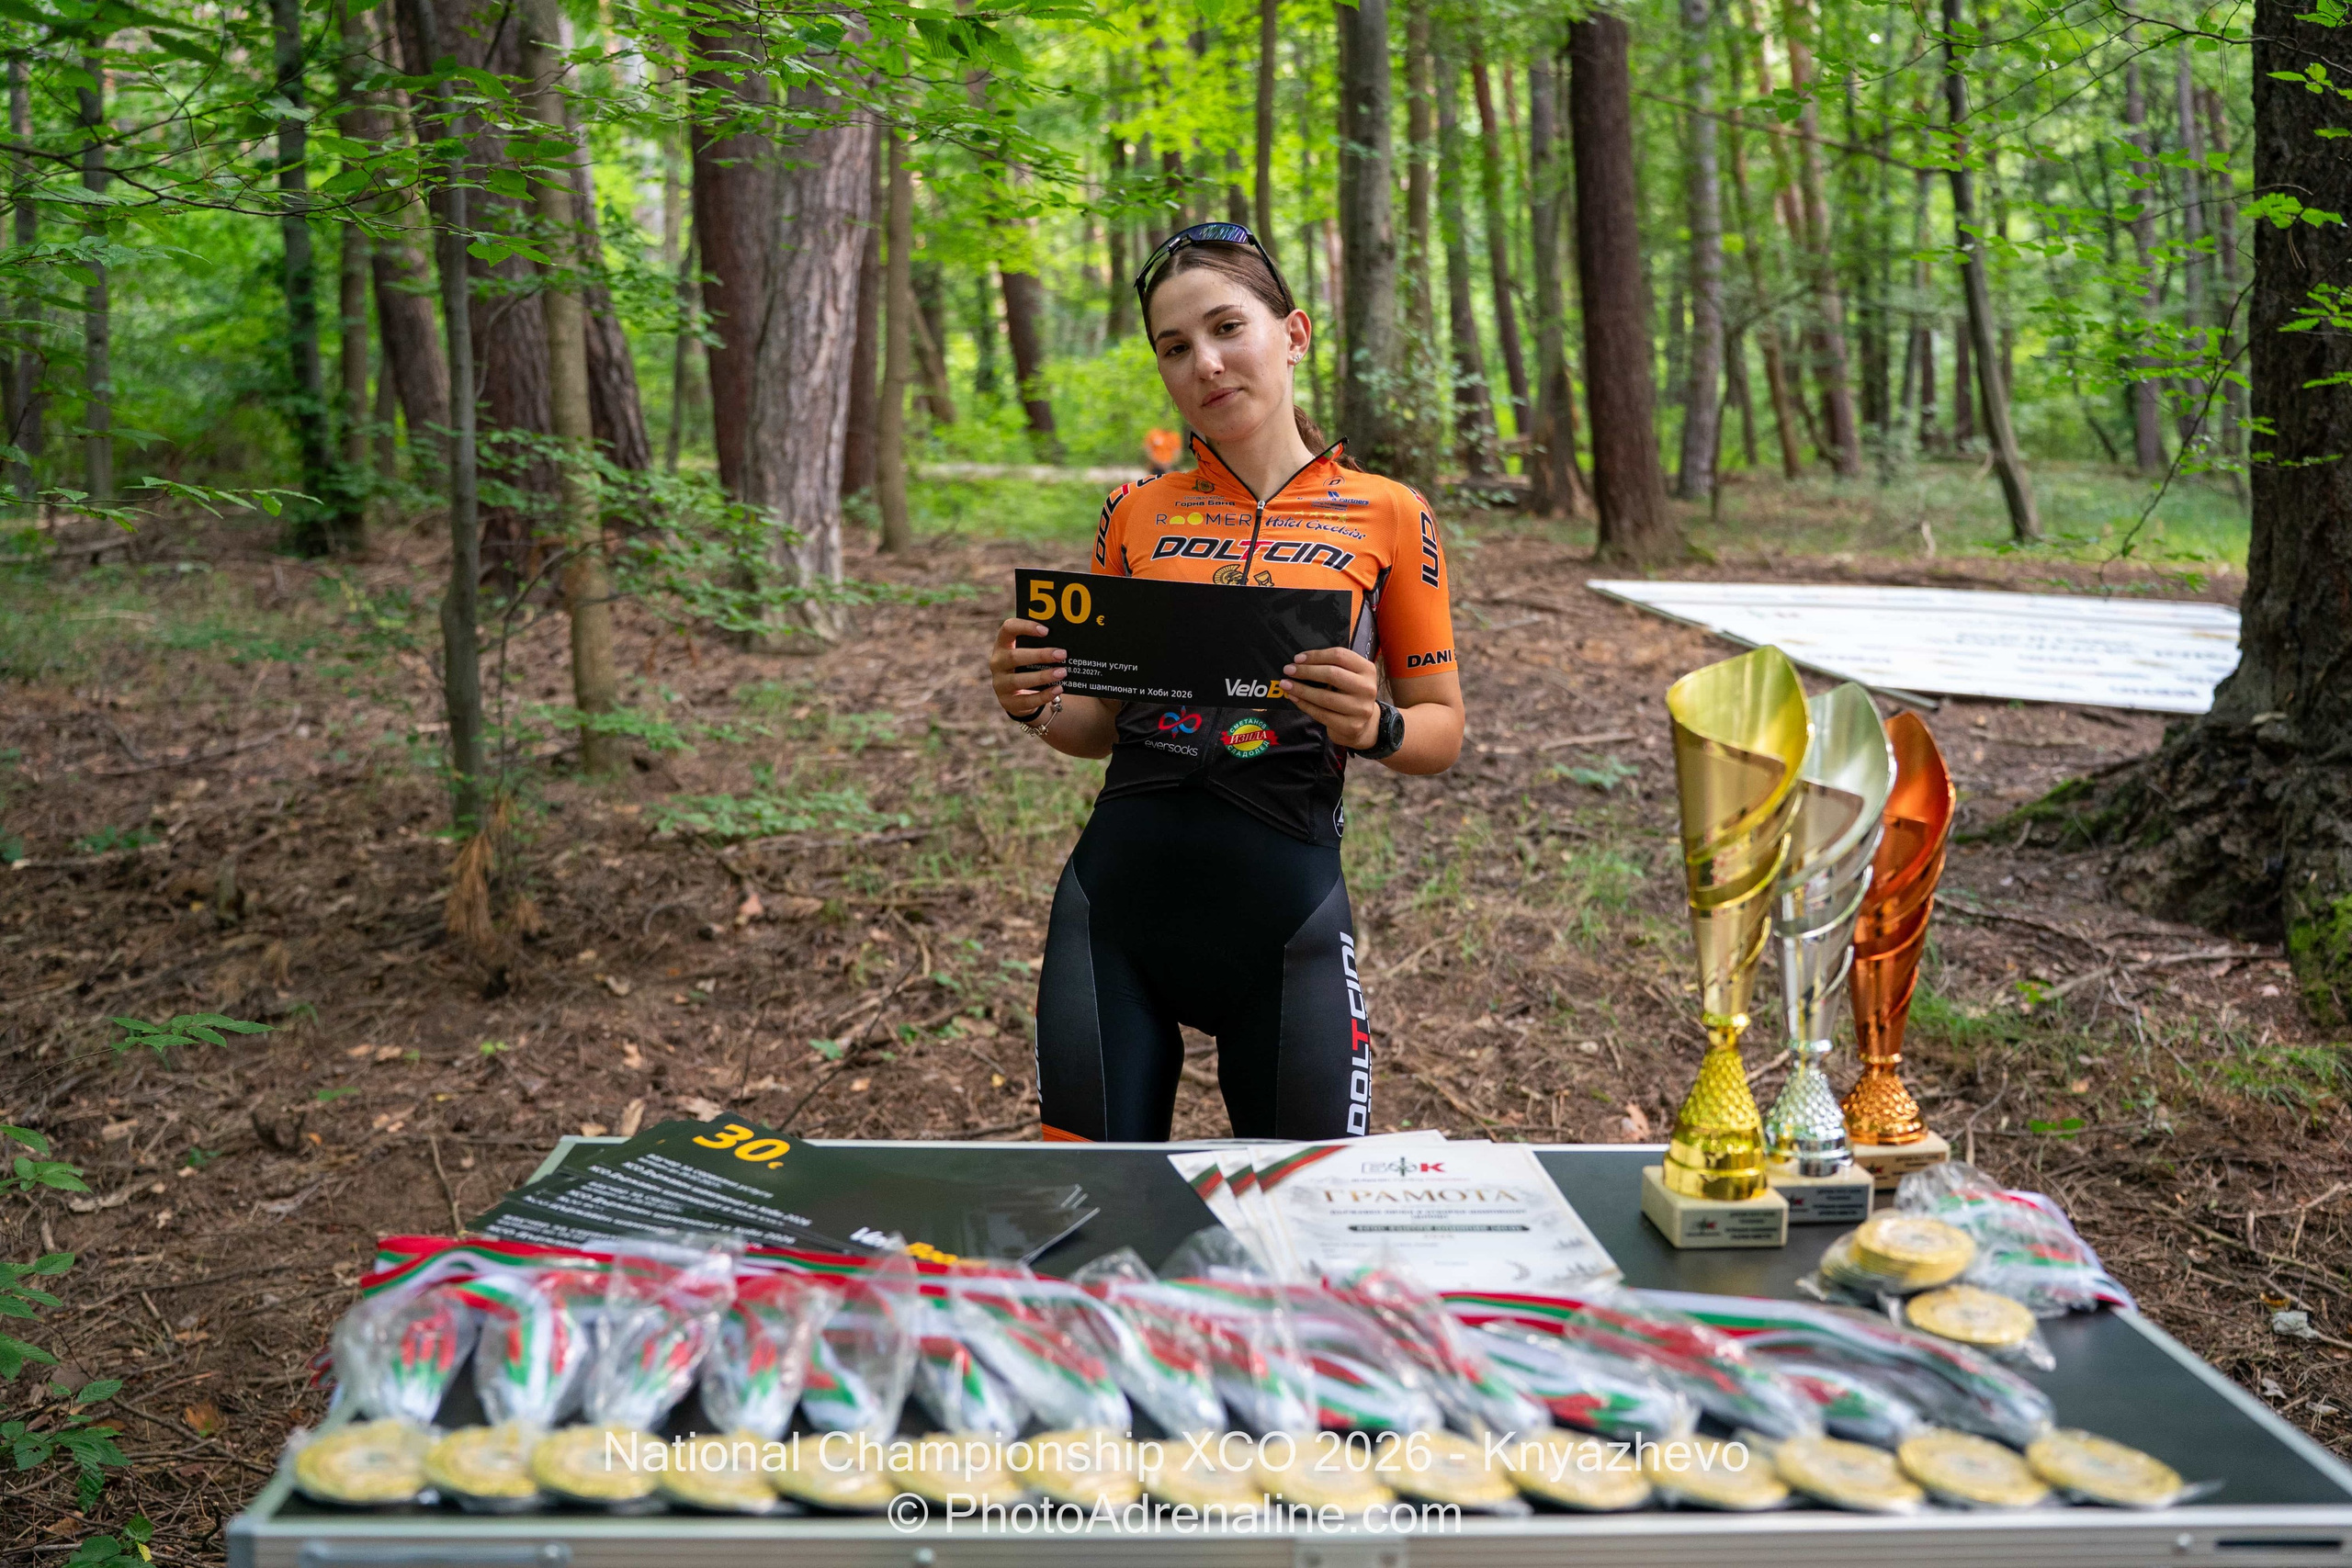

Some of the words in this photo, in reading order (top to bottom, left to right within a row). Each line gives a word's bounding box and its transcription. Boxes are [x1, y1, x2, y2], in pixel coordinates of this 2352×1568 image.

[1265, 515, 1303, 528] Hotel
[1306, 519, 1367, 540] Excelsior
[1150, 535, 1355, 571] DOLTCINI
[1028, 579, 1091, 625] 50
[1068, 657, 1107, 669] сервизни
[1109, 660, 1138, 672] услуги
[1406, 649, 1453, 670] DANI
[1065, 666, 1103, 677] 8.02.2027г.
[1089, 682, 1138, 694] шампионат
[1147, 687, 1169, 697] Хоби
[1170, 689, 1193, 699] 2026
[1225, 678, 1291, 699] VeloB
[1229, 730, 1268, 744] ИЗИДА
[1144, 739, 1199, 758] eversocks
[1227, 739, 1271, 759] СЛАДОЛЕД
[1340, 931, 1370, 1137] DOLTCINI
[692, 1123, 791, 1162] 30
[1320, 1189, 1520, 1203] ГРАМОТА
